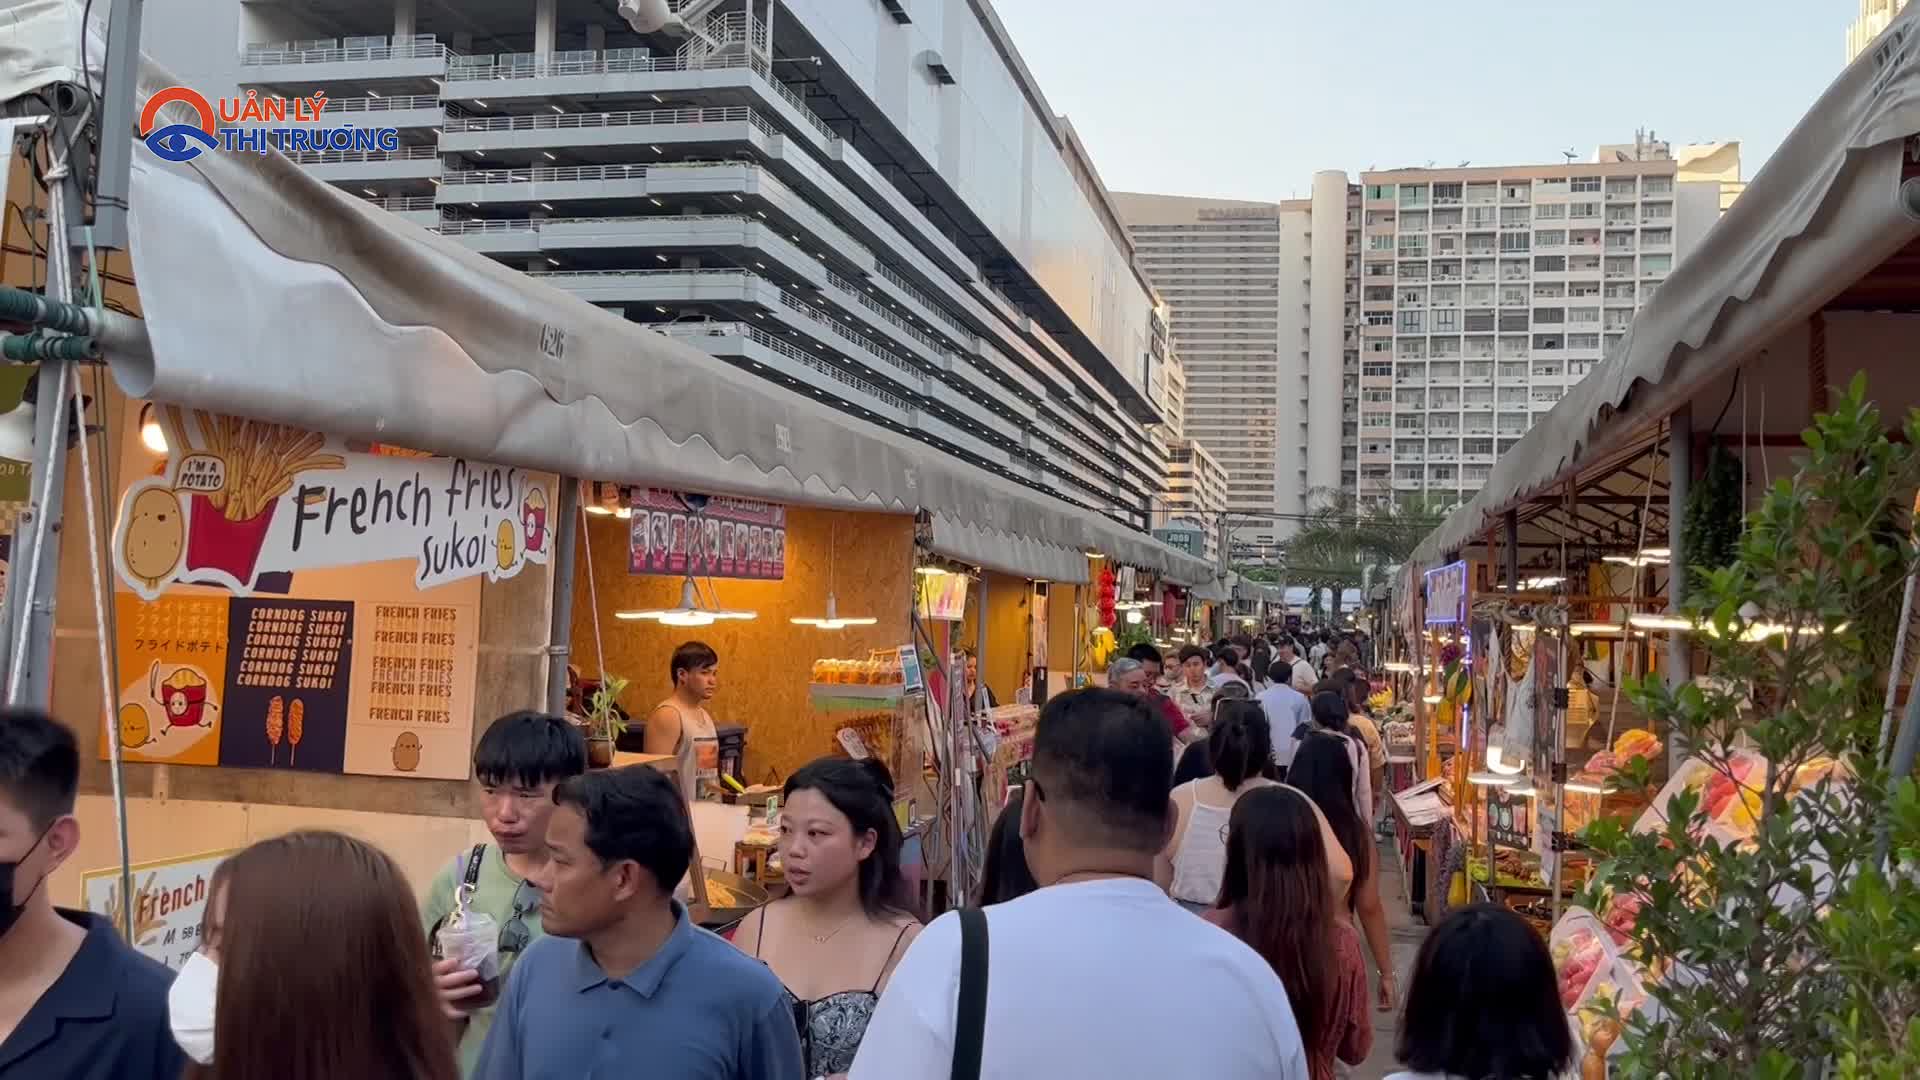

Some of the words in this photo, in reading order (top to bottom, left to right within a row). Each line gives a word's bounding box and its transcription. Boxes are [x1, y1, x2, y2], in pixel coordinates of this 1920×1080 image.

[209, 461, 217, 473] A
[180, 473, 221, 487] POTATO
[291, 471, 432, 552] French
[445, 458, 516, 518] fries
[420, 514, 488, 581] sukoi
[251, 607, 305, 620] CORNDOG
[310, 609, 347, 622] SUKOI
[375, 605, 420, 619] FRENCH
[423, 607, 456, 621] FRIES
[248, 621, 303, 633] CORNDOG
[307, 623, 344, 635] SUKOI
[246, 634, 300, 647] CORNDOG
[304, 636, 342, 648] SUKOI
[374, 631, 418, 644] FRENCH
[422, 632, 455, 646] FRIES
[243, 647, 297, 660] CORNDOG
[301, 649, 339, 662] SUKOI
[239, 660, 294, 674] CORNDOG
[299, 663, 335, 676] SUKOI
[372, 655, 416, 669] FRENCH
[420, 658, 453, 672] FRIES
[236, 673, 291, 687] CORNDOG
[296, 676, 332, 688] SUKOI
[370, 682, 414, 695] FRENCH
[419, 684, 452, 697] FRIES
[369, 707, 413, 721] FRENCH
[417, 709, 450, 723] FRIES
[136, 874, 205, 923] French
[163, 928, 176, 945] M
